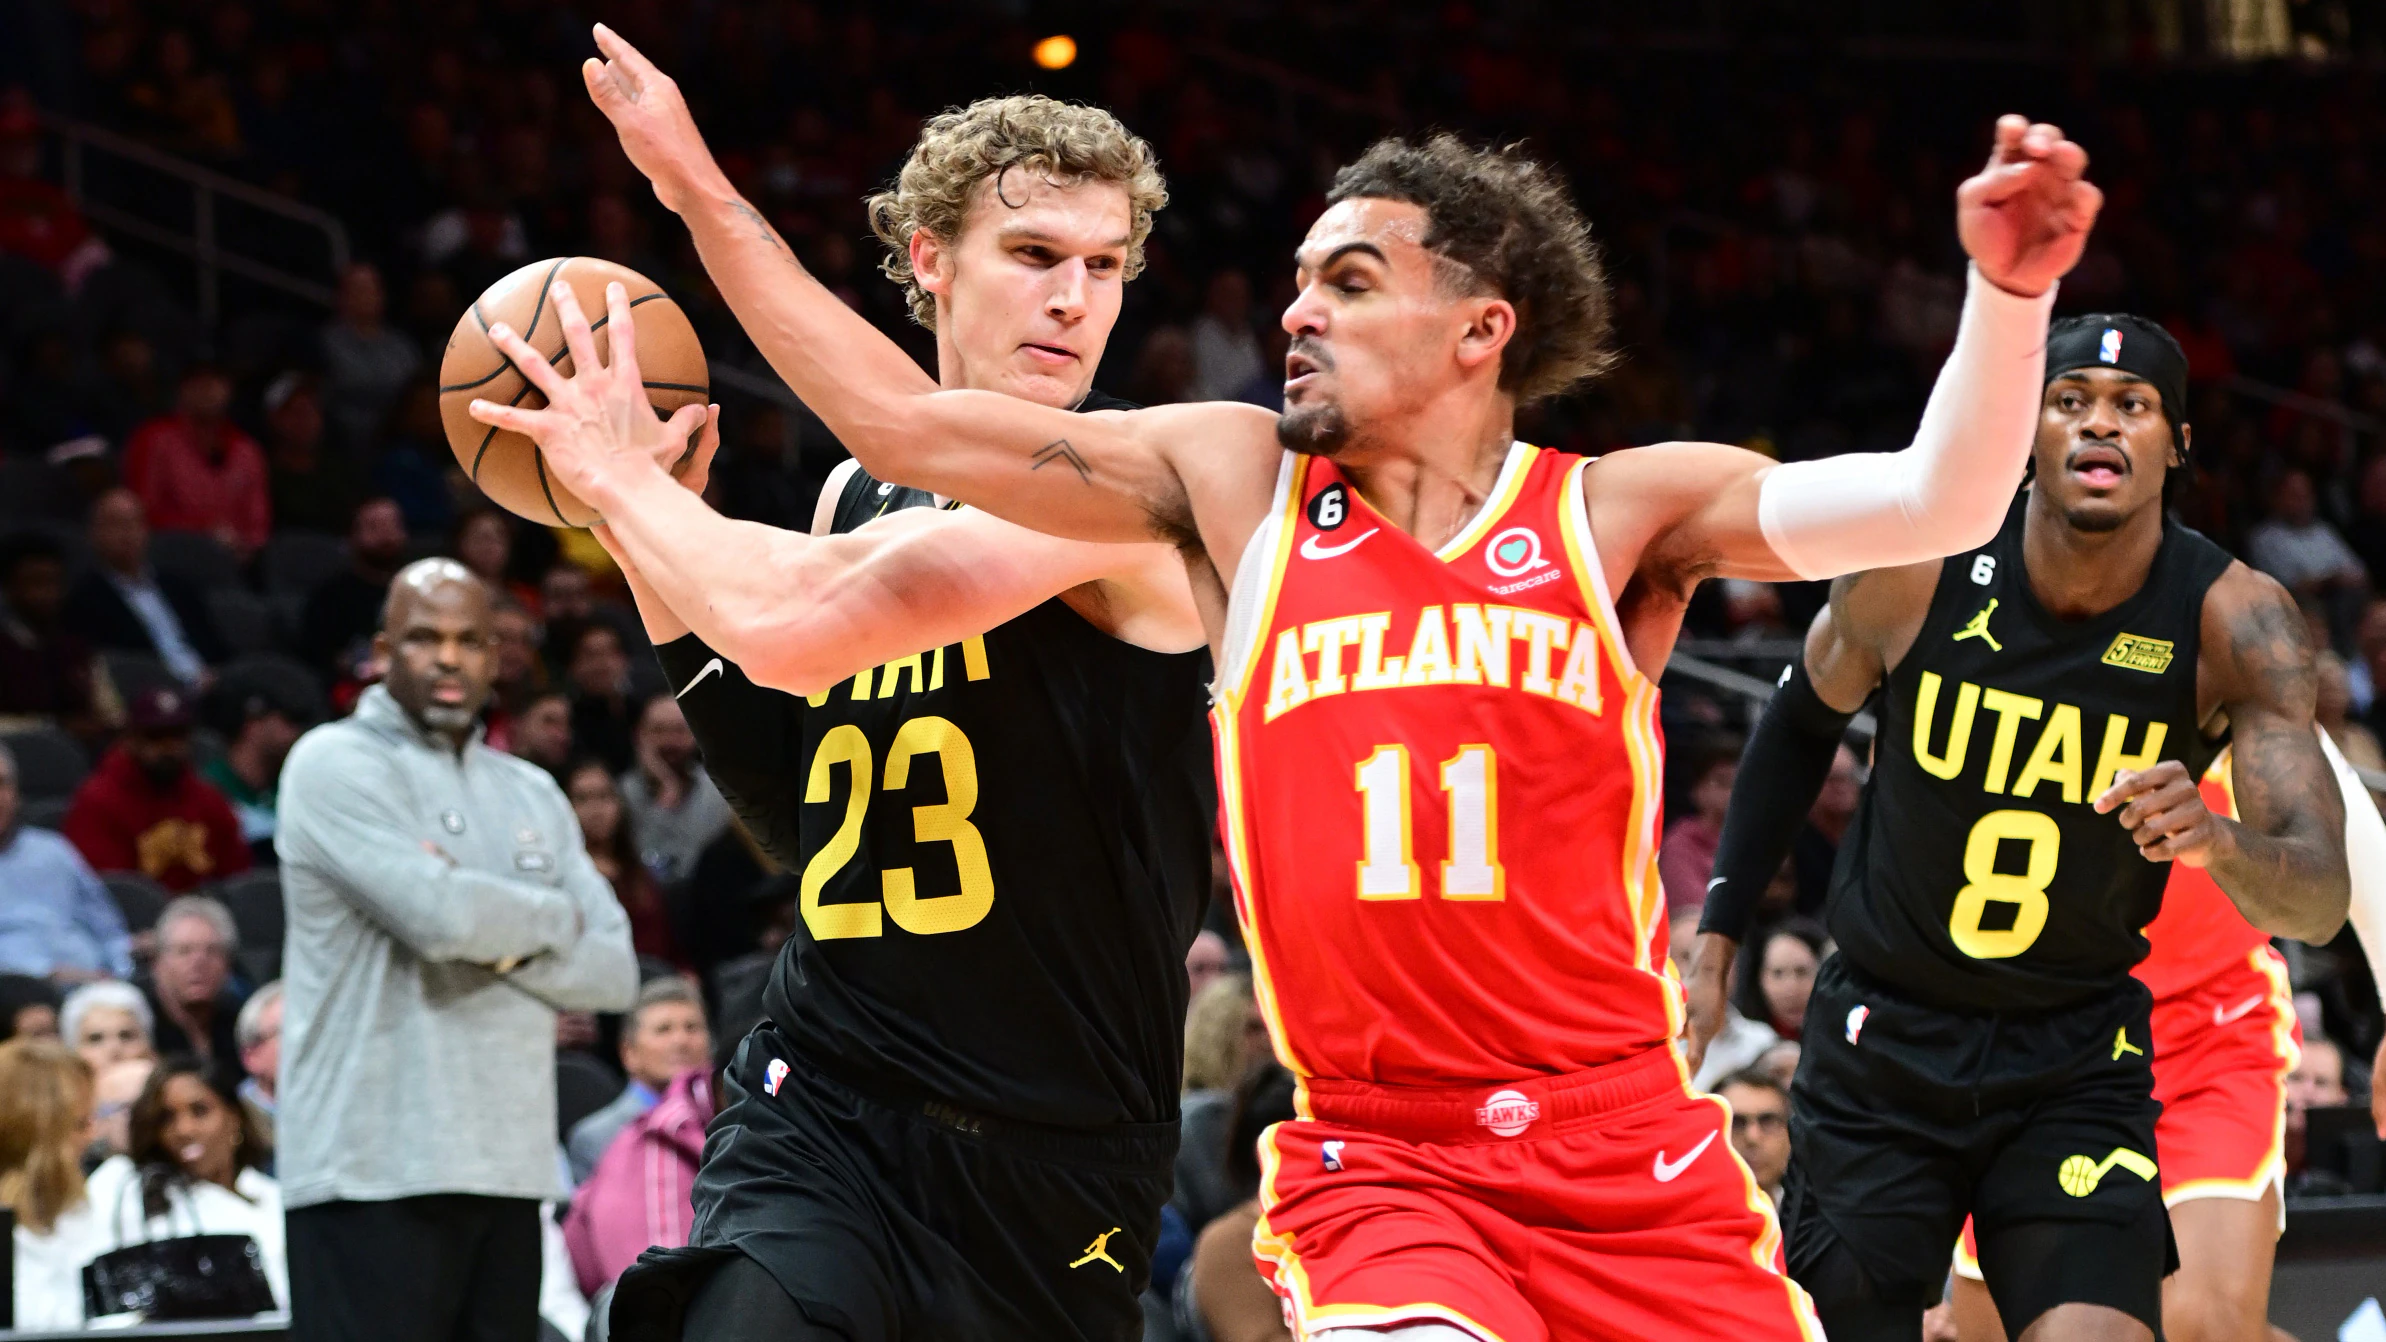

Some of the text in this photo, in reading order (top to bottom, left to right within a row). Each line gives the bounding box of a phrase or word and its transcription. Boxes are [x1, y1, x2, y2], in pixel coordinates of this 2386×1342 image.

[1317, 489, 1343, 527] 6
[1970, 554, 1996, 586] 6
[1264, 603, 1604, 725] ATLANTA
[2111, 638, 2133, 661] 5
[1912, 670, 2169, 805] UTAH
[800, 715, 995, 941] 23
[1355, 743, 1506, 902] 11
[1949, 809, 2061, 959] 8
[1477, 1104, 1540, 1124] HAWKS
